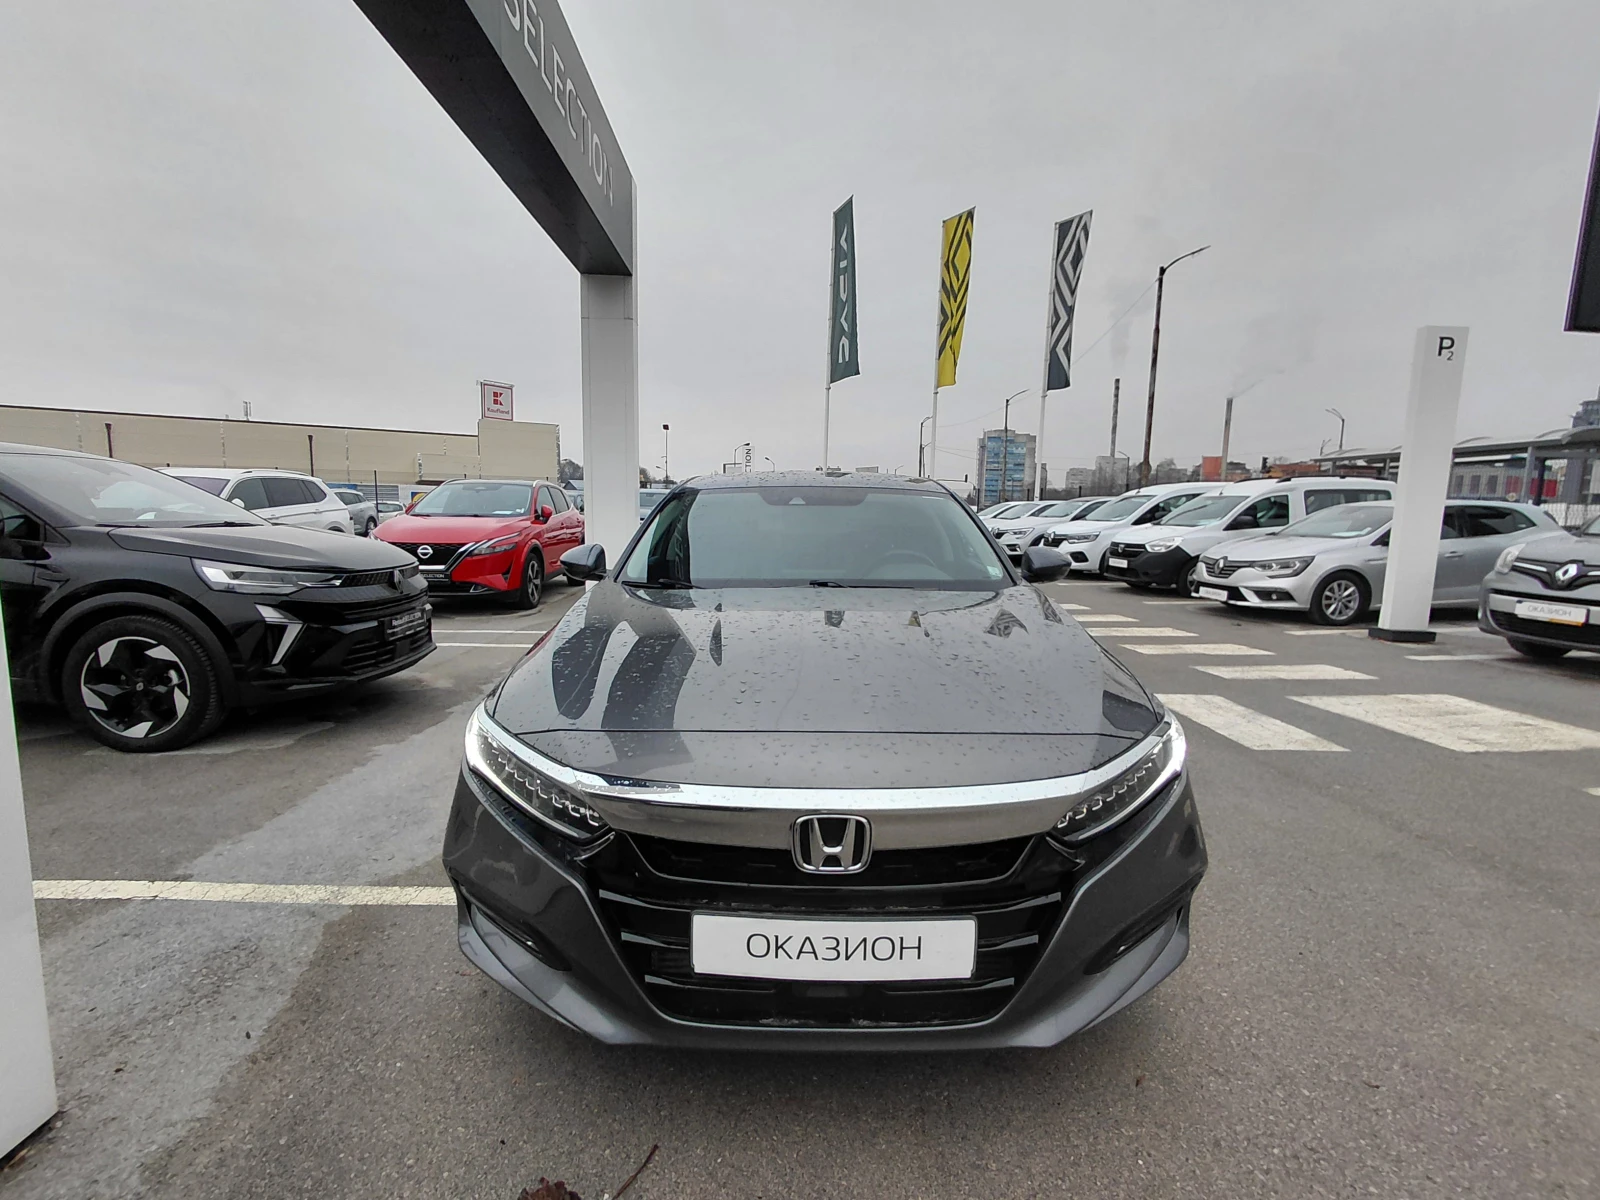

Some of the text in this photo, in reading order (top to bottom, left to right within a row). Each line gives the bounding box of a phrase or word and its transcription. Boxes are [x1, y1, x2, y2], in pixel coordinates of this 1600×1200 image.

[487, 407, 510, 415] Kaufland
[1527, 604, 1572, 617] ОКАЗИОН
[746, 933, 922, 962] ОКАЗИОН
